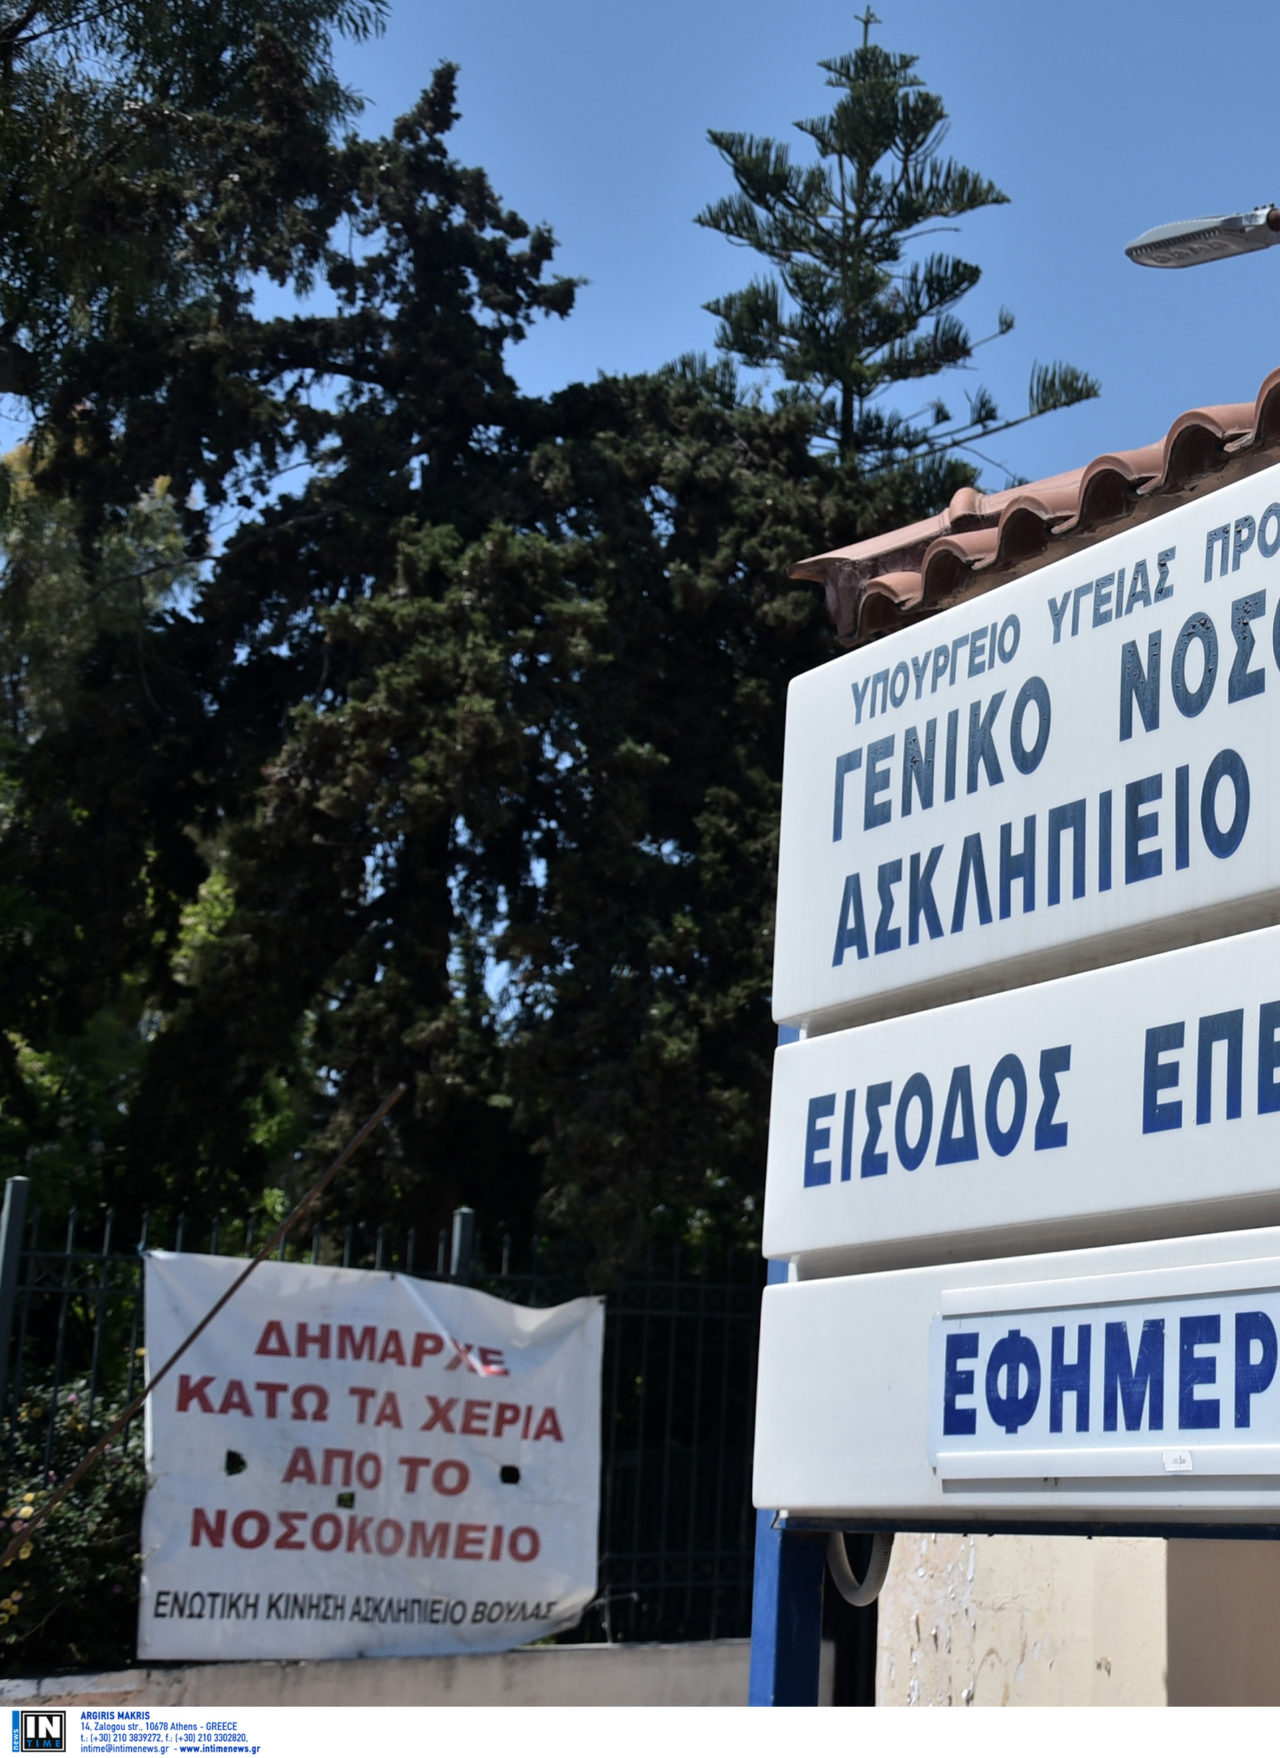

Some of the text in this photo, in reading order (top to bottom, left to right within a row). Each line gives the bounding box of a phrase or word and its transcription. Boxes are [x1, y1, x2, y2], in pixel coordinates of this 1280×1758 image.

[851, 612, 1022, 725] ΥΠΟΥΡΓΕΙΟ
[1047, 546, 1176, 644] ΥΓΕΙΑΣ
[832, 675, 1051, 843] ΓΕΝΙΚΟ
[832, 747, 1250, 968] ΑΣΚΛΗΠΙΕΙΟ
[803, 1043, 1071, 1189] ΕΙΣΟΔΟΣ
[255, 1319, 509, 1377] ΔΗΜΑΡΧΕ
[176, 1374, 564, 1443] ΚΑΤΩ ΤΑ ΧΕΡΙΑ
[282, 1446, 470, 1497] ΑΠΟ ΤΟ
[190, 1508, 541, 1563] ΝΟΣΟΚΟΜΕΙΟ
[153, 1590, 557, 1625] ΕΝΩΤΙΚΗ ΚΙΝΗΣΗ ΑΣΚΛΗΠΙΕΙΟ ΒΟΥΛΑΣ
